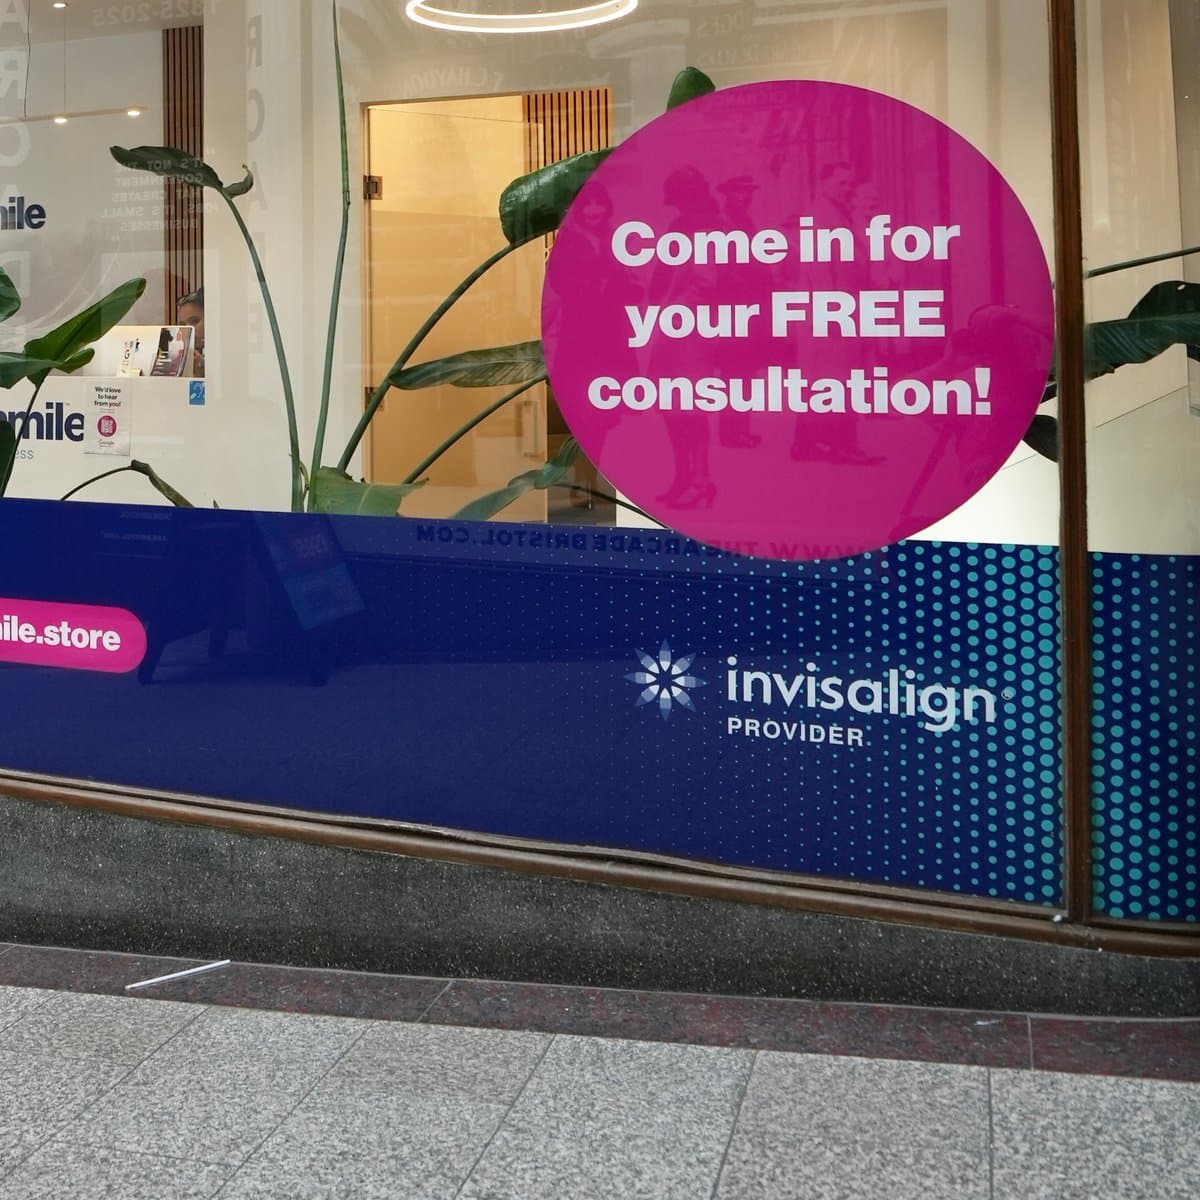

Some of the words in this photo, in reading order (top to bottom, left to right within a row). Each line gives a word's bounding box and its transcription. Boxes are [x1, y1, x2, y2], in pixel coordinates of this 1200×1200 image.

[611, 221, 788, 266] Come
[799, 216, 854, 262] in
[865, 215, 961, 261] for
[624, 303, 760, 348] your
[771, 290, 946, 337] FREE
[587, 365, 991, 415] consultation!
[726, 656, 996, 732] invisalign
[727, 716, 864, 747] PROVIDER
